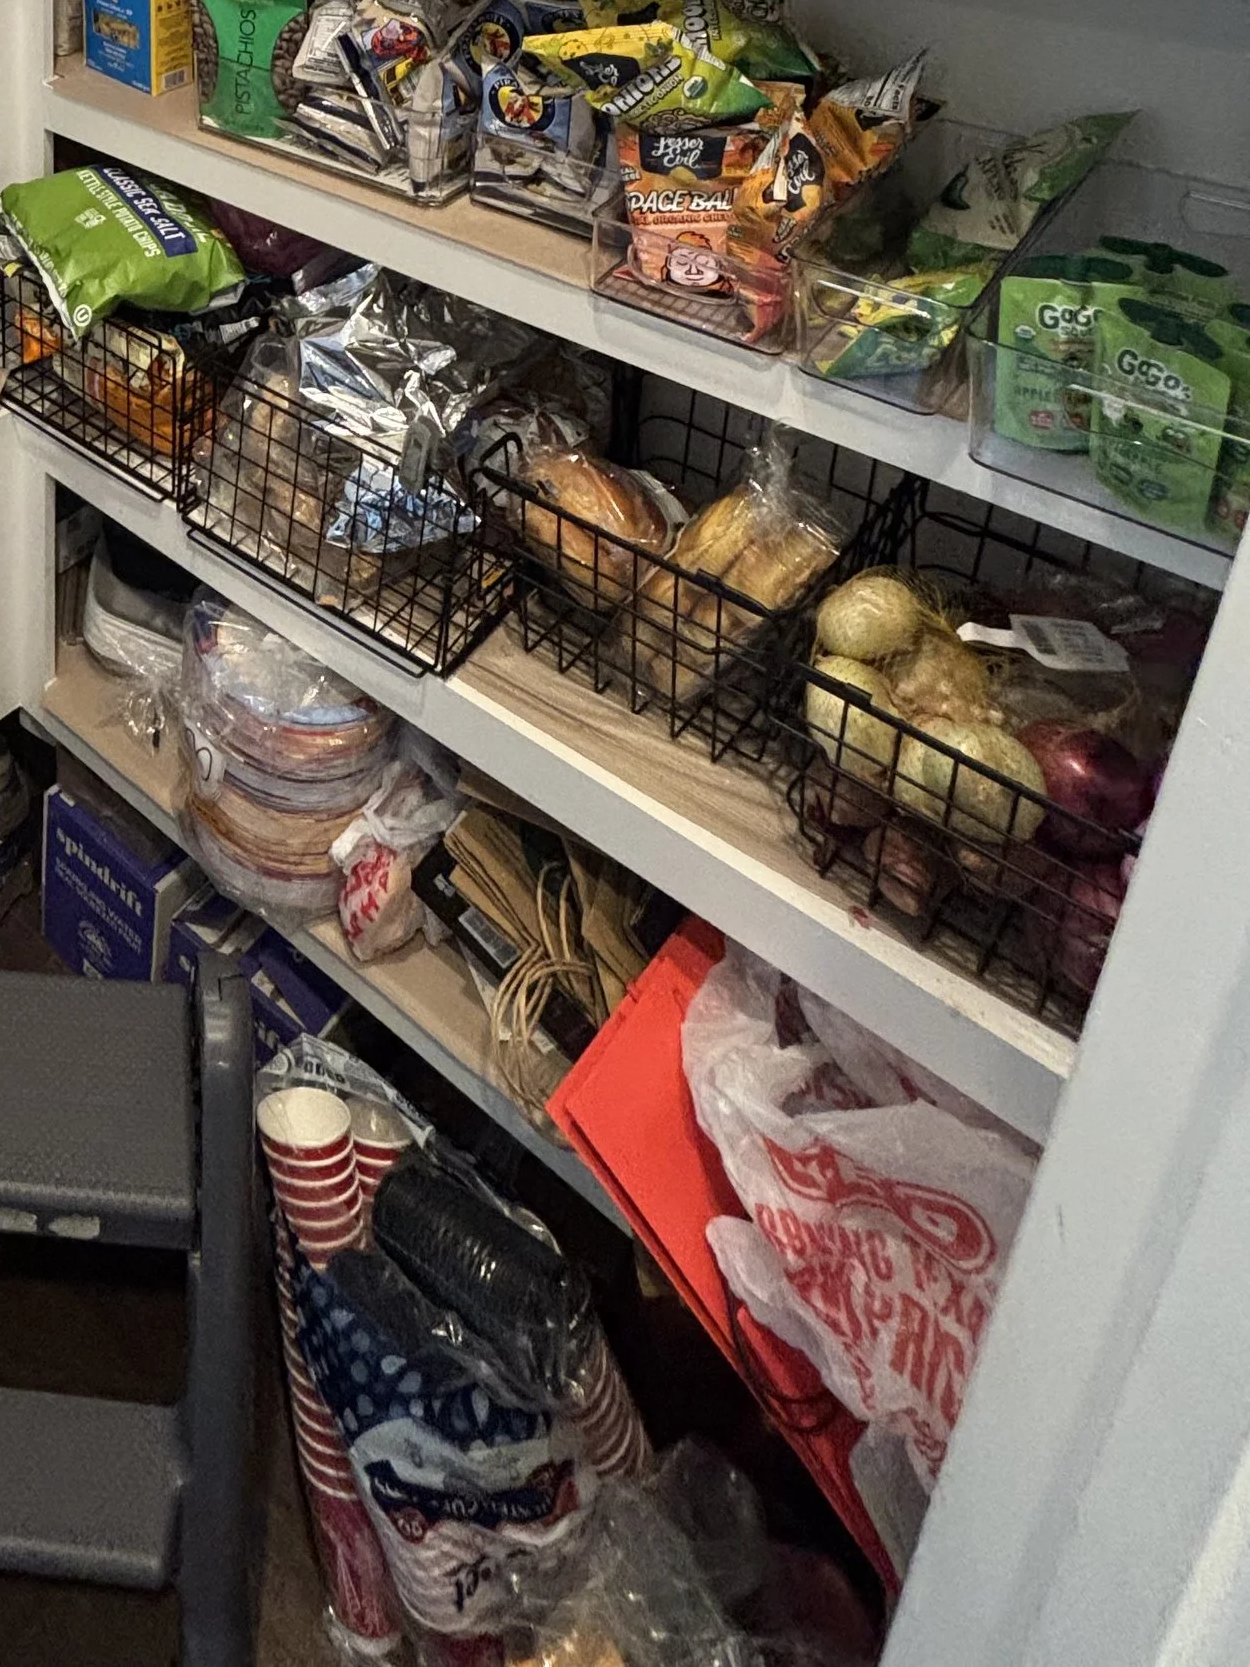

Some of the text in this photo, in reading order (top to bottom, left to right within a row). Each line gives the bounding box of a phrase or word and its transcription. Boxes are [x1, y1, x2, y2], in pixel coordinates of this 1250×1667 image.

[235, 9, 256, 116] PISTACHIOS
[652, 135, 704, 156] Lesser
[664, 147, 701, 169] Evil
[76, 170, 161, 258] KETTLE STYLE POTATO CHIPS
[103, 167, 136, 197] CLASSIC
[134, 195, 157, 215] SEA
[150, 215, 186, 241] SALT
[1117, 348, 1183, 391] GoGo
[56, 827, 143, 918] spindrift
